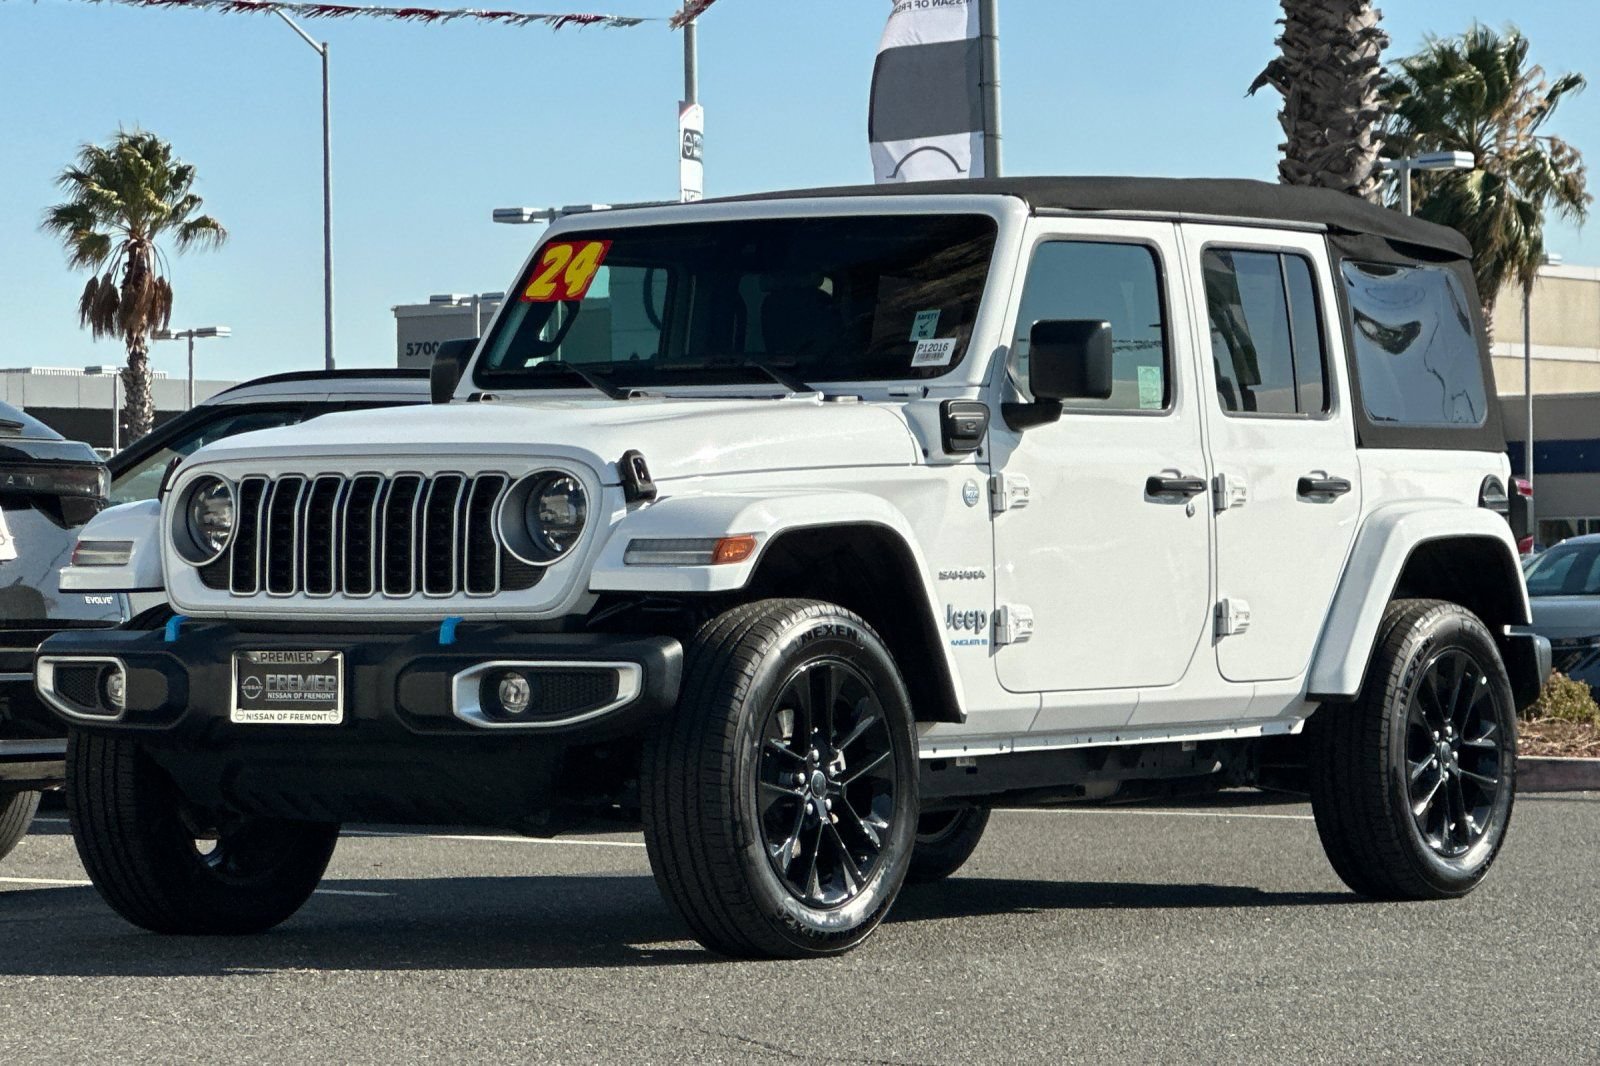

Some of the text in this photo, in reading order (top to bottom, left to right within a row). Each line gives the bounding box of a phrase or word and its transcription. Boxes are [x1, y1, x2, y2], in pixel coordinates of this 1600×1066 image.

[525, 242, 604, 299] 24
[938, 570, 986, 580] SAHARA
[945, 604, 987, 635] Jeep
[799, 624, 859, 645] NEXEN
[260, 652, 314, 662] PREMIER
[265, 674, 337, 691] PREMIER
[246, 713, 328, 721] NISSAN OF FREMONT
